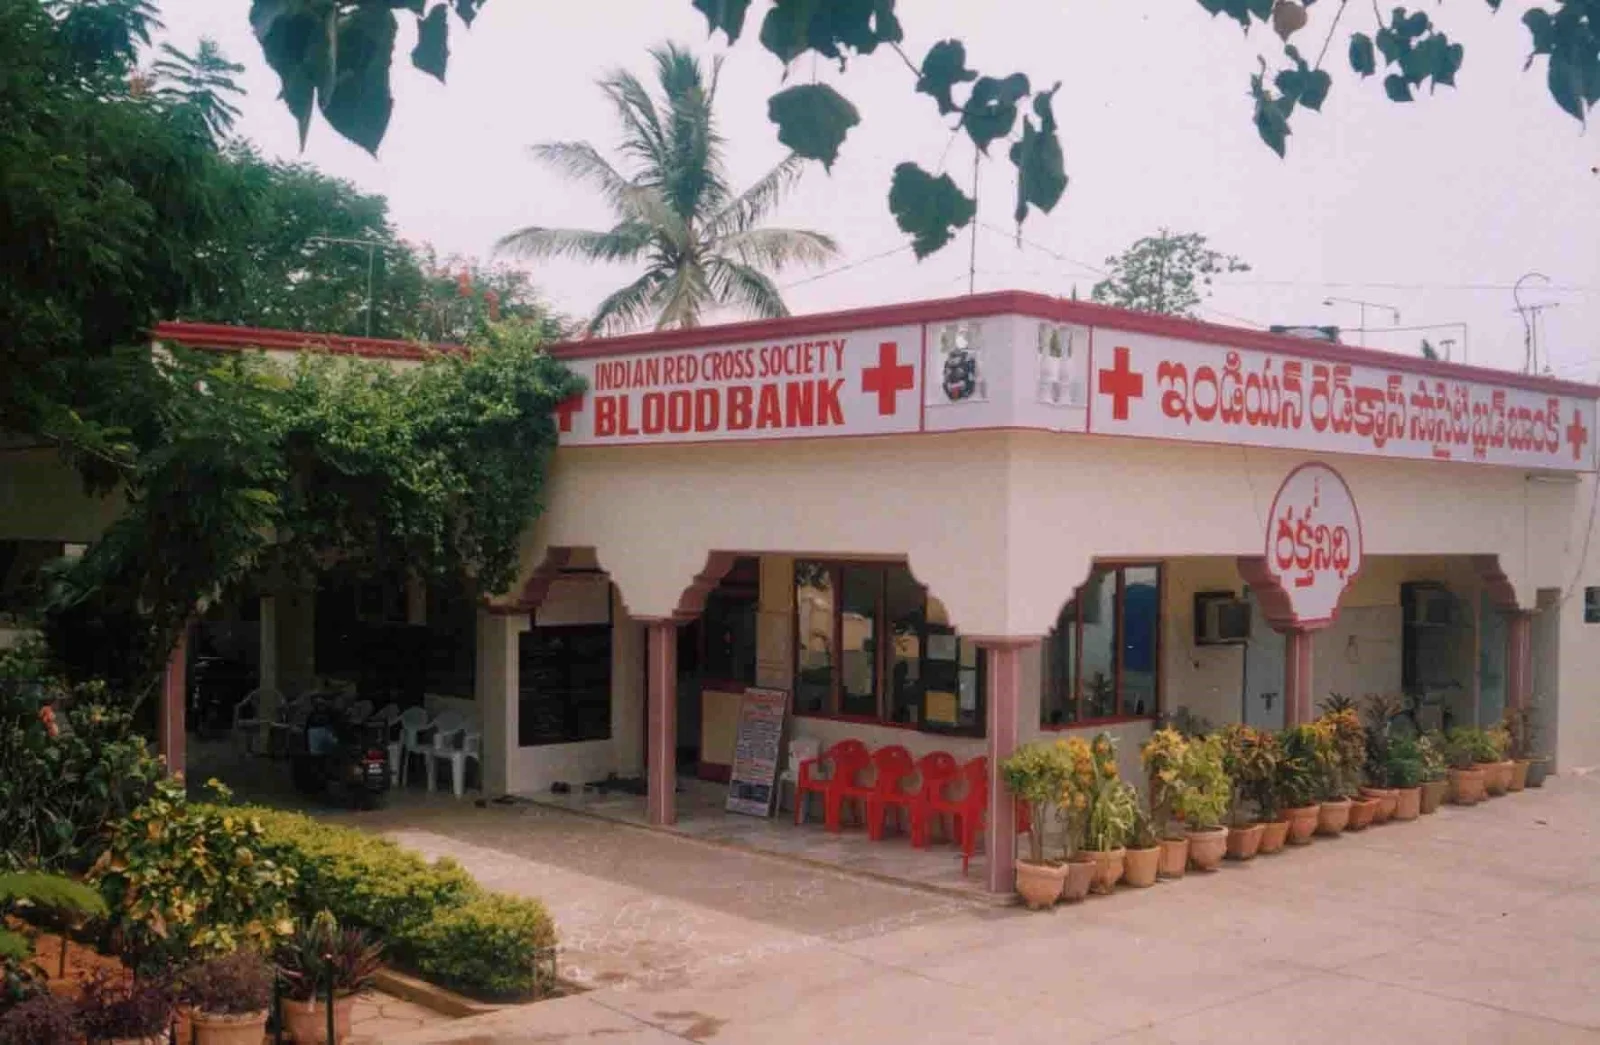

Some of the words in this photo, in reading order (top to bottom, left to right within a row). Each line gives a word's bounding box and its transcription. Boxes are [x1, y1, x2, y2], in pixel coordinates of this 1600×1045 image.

[594, 357, 660, 391] INDIAN
[663, 353, 699, 385] RED
[701, 348, 755, 383] CROSS
[759, 338, 846, 377] SOCIETY
[1157, 351, 1303, 430] ఇండియన్
[594, 387, 720, 437] BLOOD
[726, 378, 845, 431] BANK
